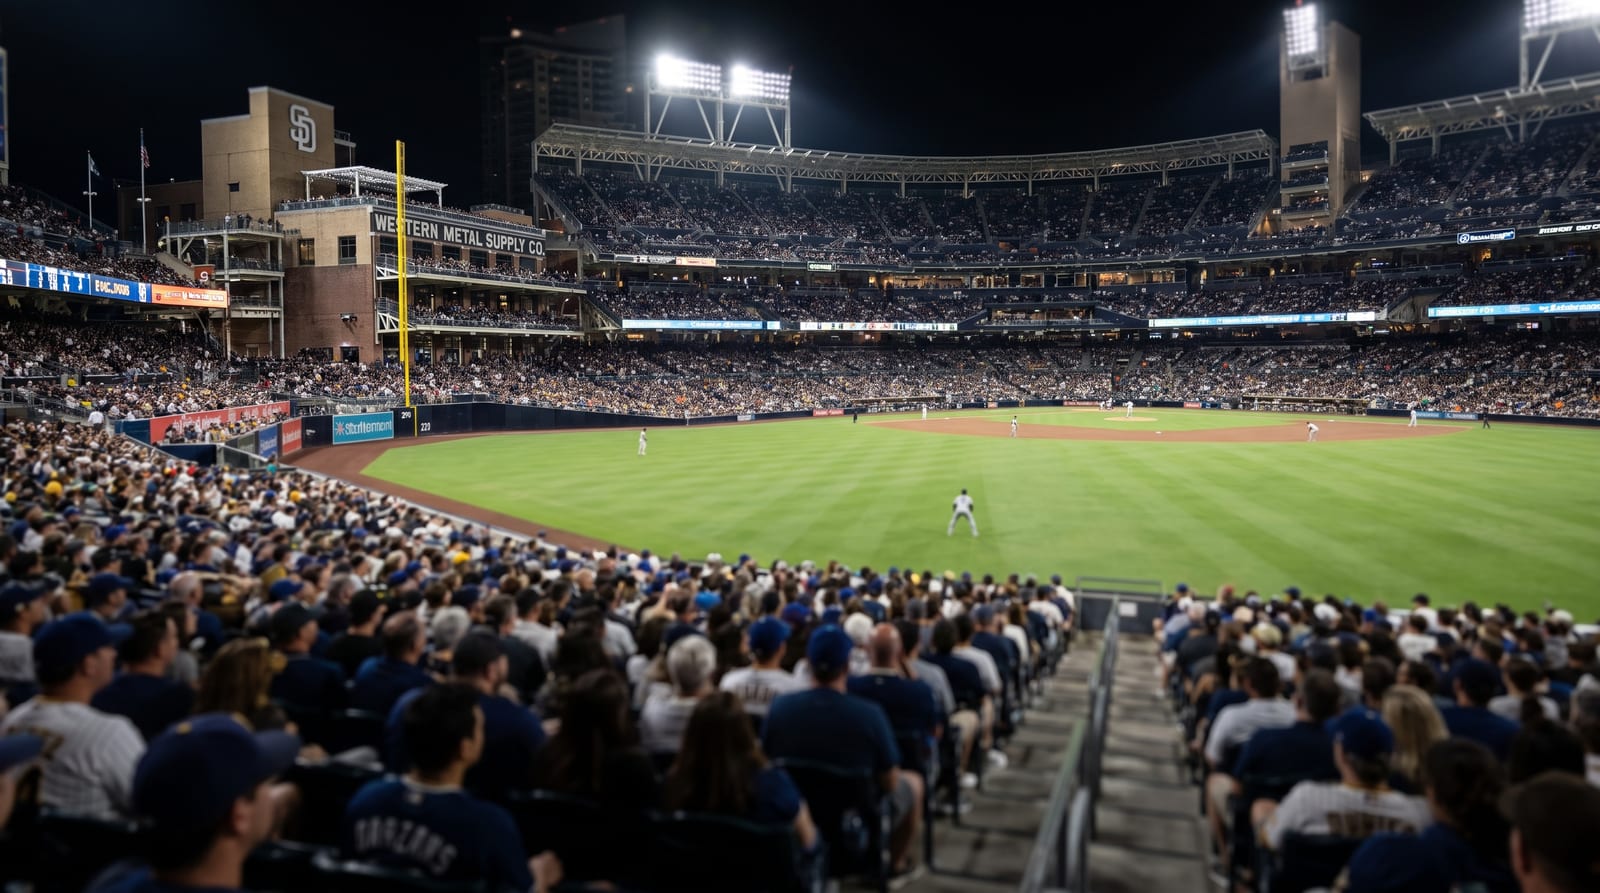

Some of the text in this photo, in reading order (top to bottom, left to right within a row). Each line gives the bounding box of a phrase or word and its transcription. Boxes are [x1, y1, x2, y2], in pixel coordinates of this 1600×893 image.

[290, 104, 316, 153] SD
[443, 225, 483, 247] METAL
[486, 233, 525, 253] SUPPLY
[529, 240, 546, 256] CO.
